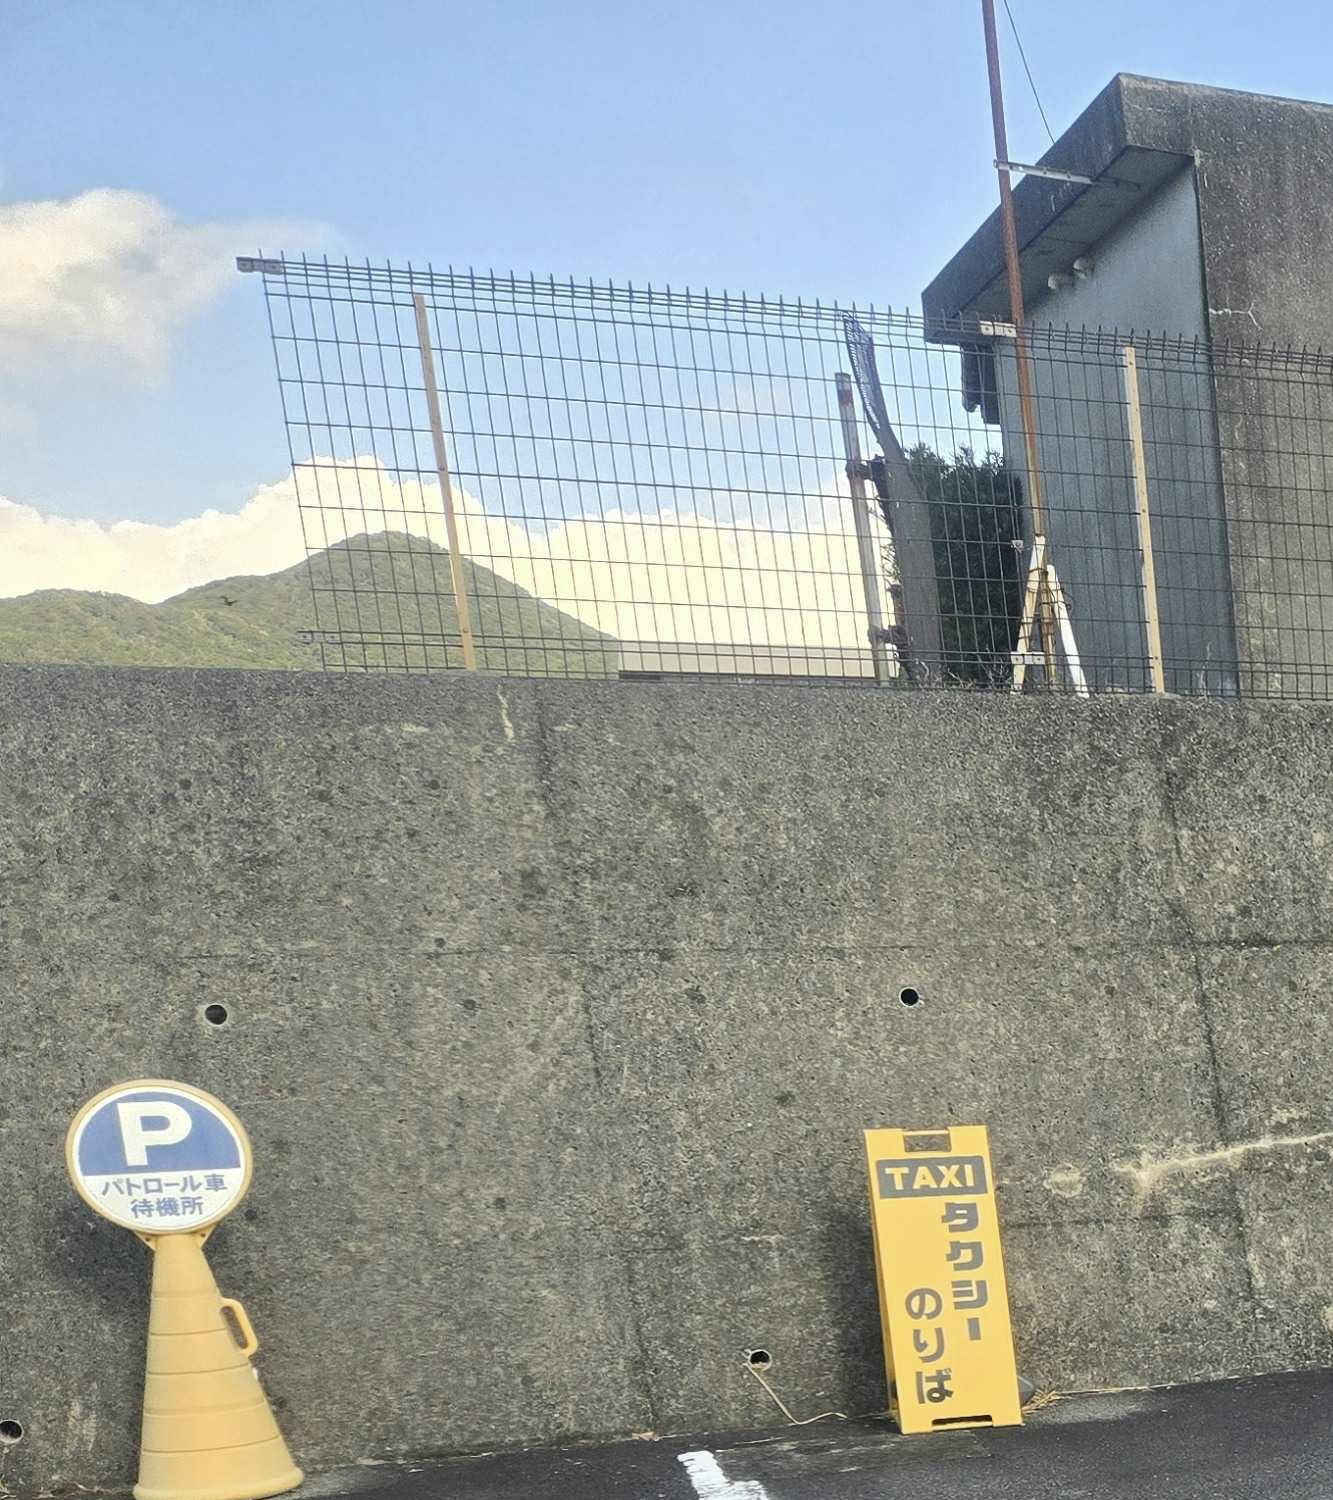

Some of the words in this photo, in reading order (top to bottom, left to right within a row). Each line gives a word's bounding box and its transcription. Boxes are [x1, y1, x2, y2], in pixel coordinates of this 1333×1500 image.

[117, 1101, 192, 1167] P
[131, 1196, 204, 1218] 待機所
[885, 1164, 976, 1190] TAXI
[941, 1202, 988, 1341] タクシー
[905, 1287, 953, 1404] のりば
